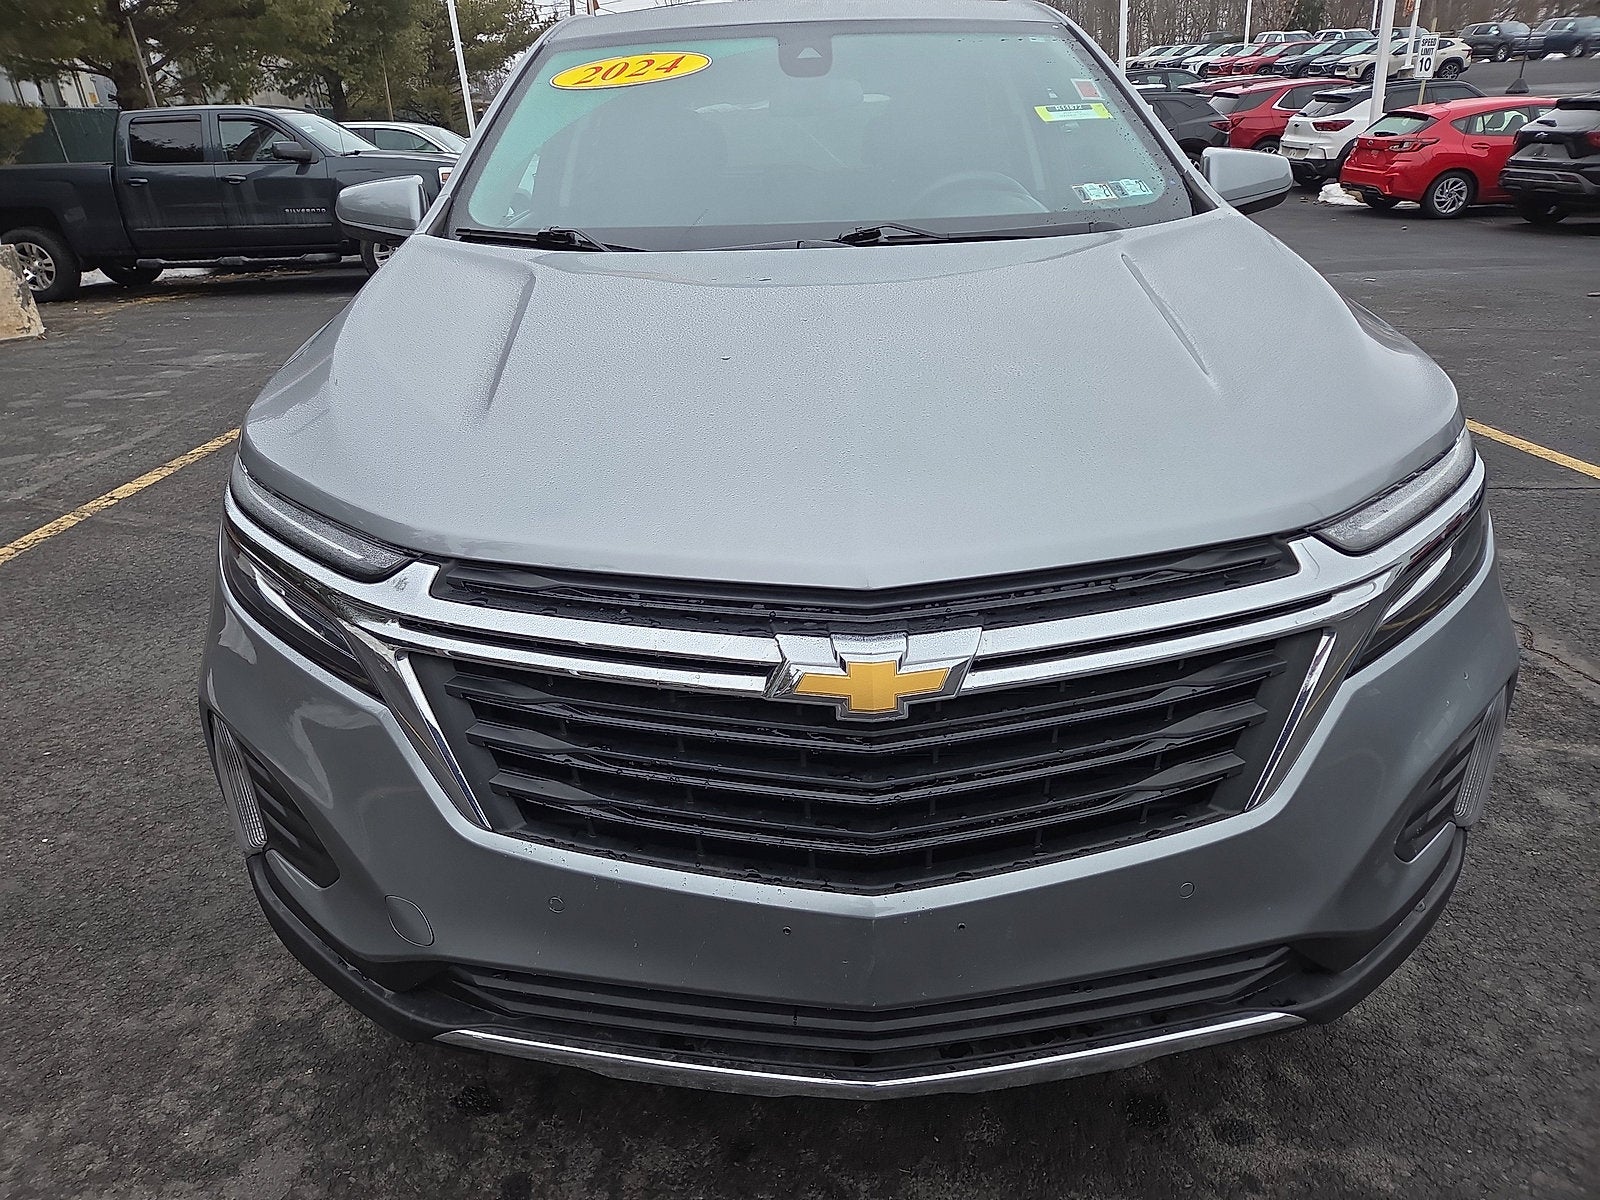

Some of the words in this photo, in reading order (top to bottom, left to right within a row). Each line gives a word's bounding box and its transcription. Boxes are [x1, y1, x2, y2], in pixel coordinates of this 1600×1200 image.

[1421, 38, 1437, 47] SPEED
[1421, 47, 1435, 55] LIMIT
[571, 54, 687, 86] 2024
[1419, 57, 1432, 72] 10
